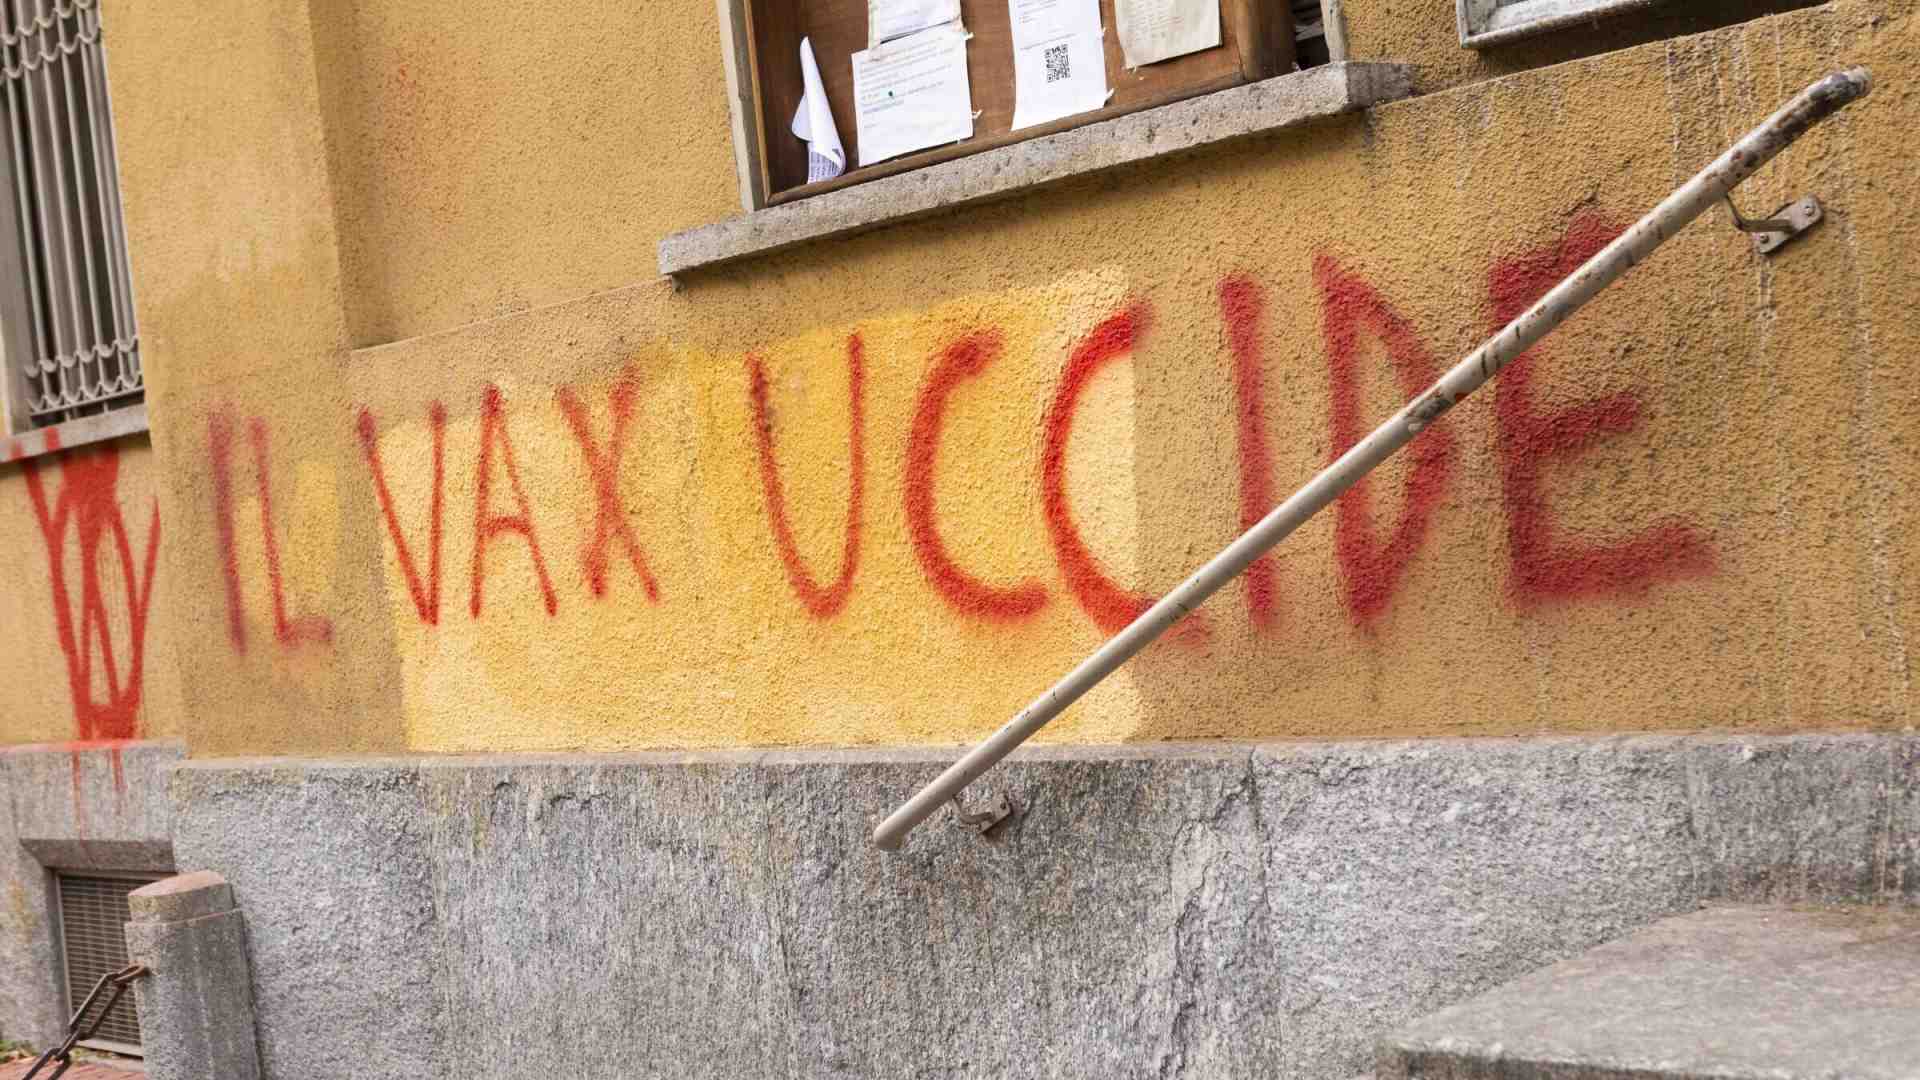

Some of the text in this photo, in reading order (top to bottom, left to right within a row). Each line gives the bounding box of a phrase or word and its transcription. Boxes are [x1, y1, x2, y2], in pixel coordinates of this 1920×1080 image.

[207, 404, 334, 658] IL
[353, 364, 660, 626] VAX
[748, 203, 1712, 644] UCCIDE
